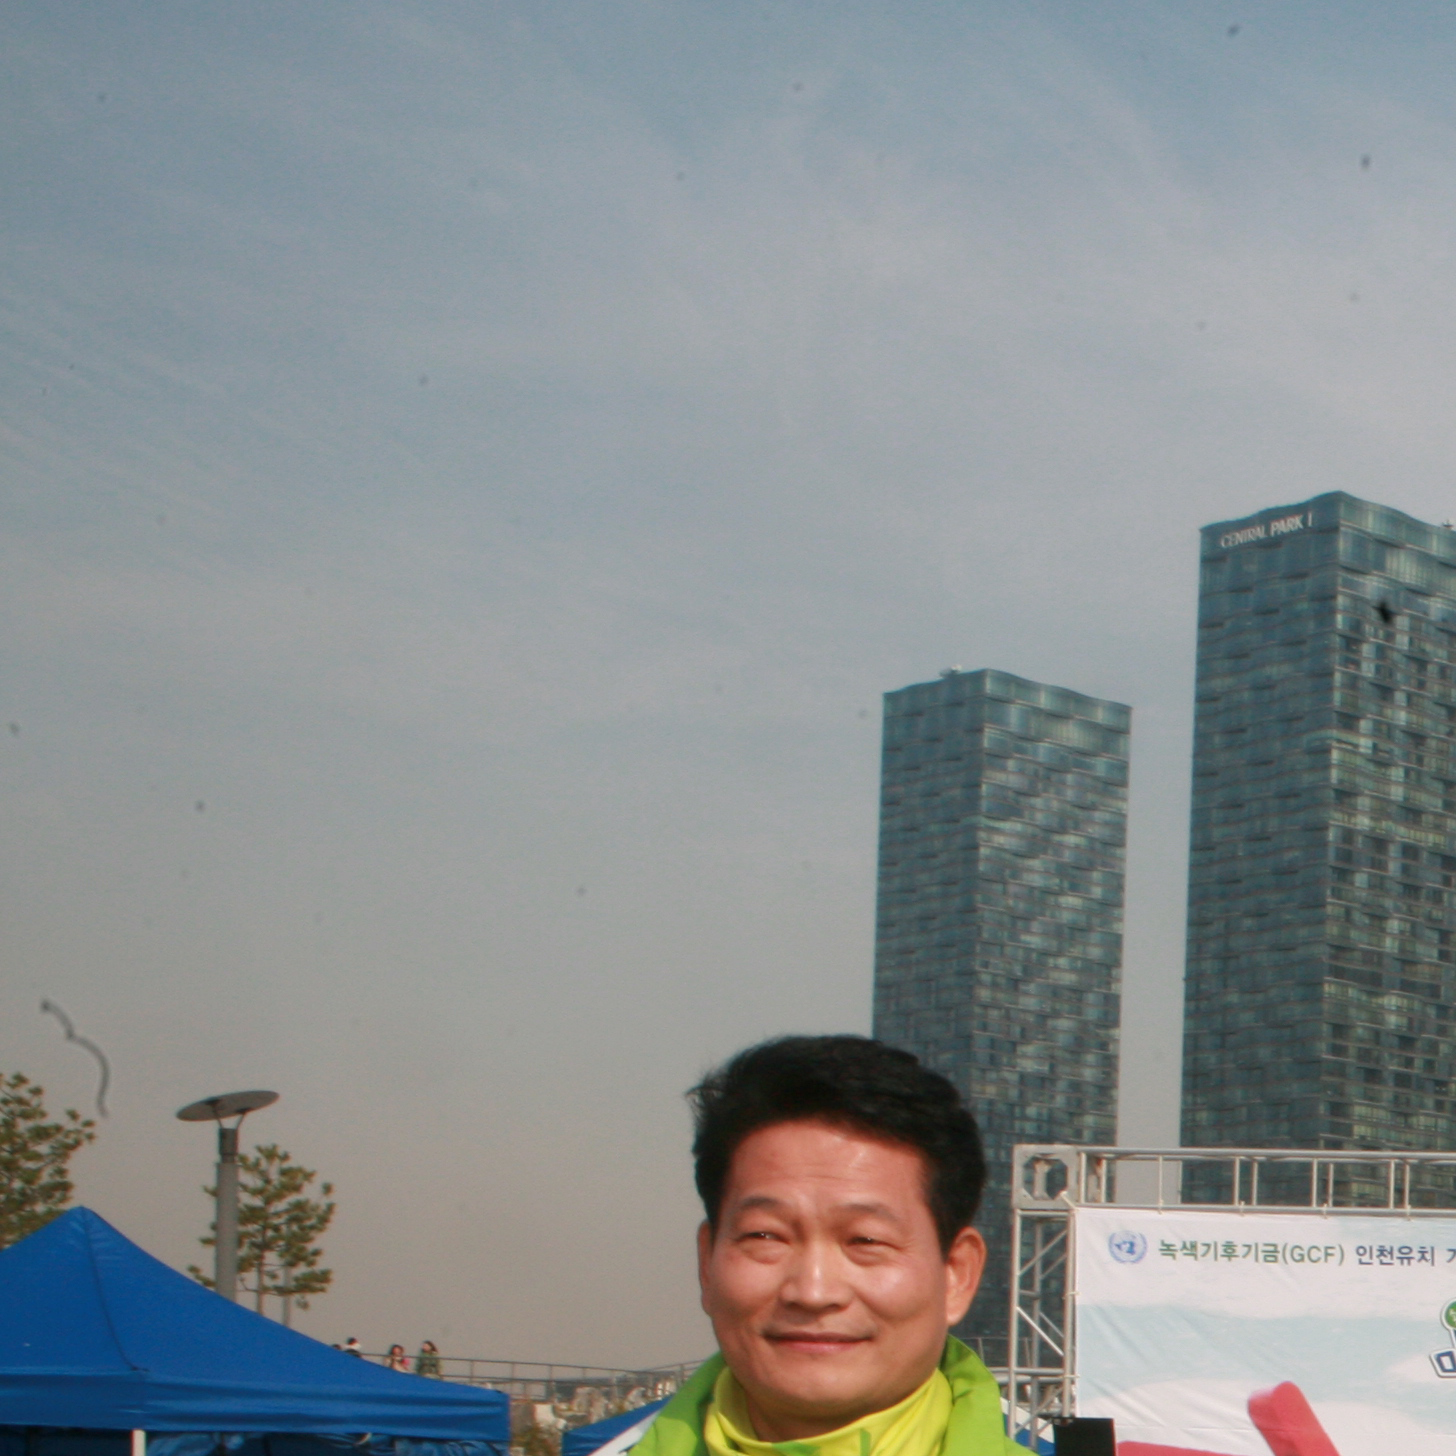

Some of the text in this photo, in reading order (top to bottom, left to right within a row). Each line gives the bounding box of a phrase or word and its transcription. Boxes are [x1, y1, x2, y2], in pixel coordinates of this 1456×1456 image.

[1221, 525, 1266, 548] CENTRAL
[1270, 514, 1303, 537] PARK
[1158, 1239, 1345, 1266] 녹색기후기금(GCF)
[1355, 1243, 1436, 1267] 인천유치
